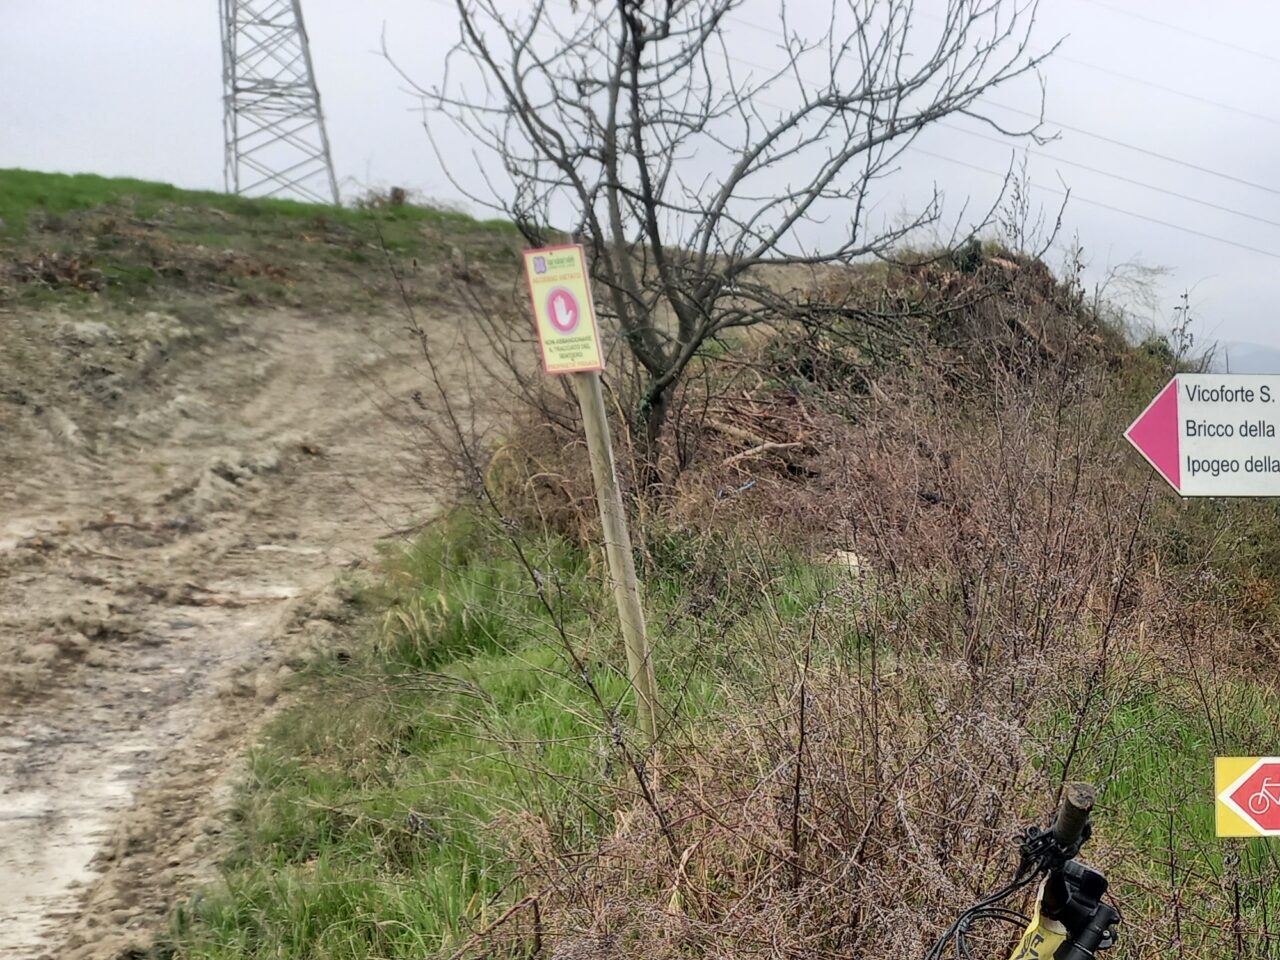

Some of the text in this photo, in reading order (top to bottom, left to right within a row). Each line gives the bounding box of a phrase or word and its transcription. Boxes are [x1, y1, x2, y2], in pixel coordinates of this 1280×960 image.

[1185, 384, 1255, 404] Vicoforte
[1260, 384, 1276, 404] S.
[1185, 420, 1234, 438] Bricco
[1239, 420, 1275, 438] della
[1186, 456, 1240, 477] Ipogeo
[1244, 456, 1280, 473] della
